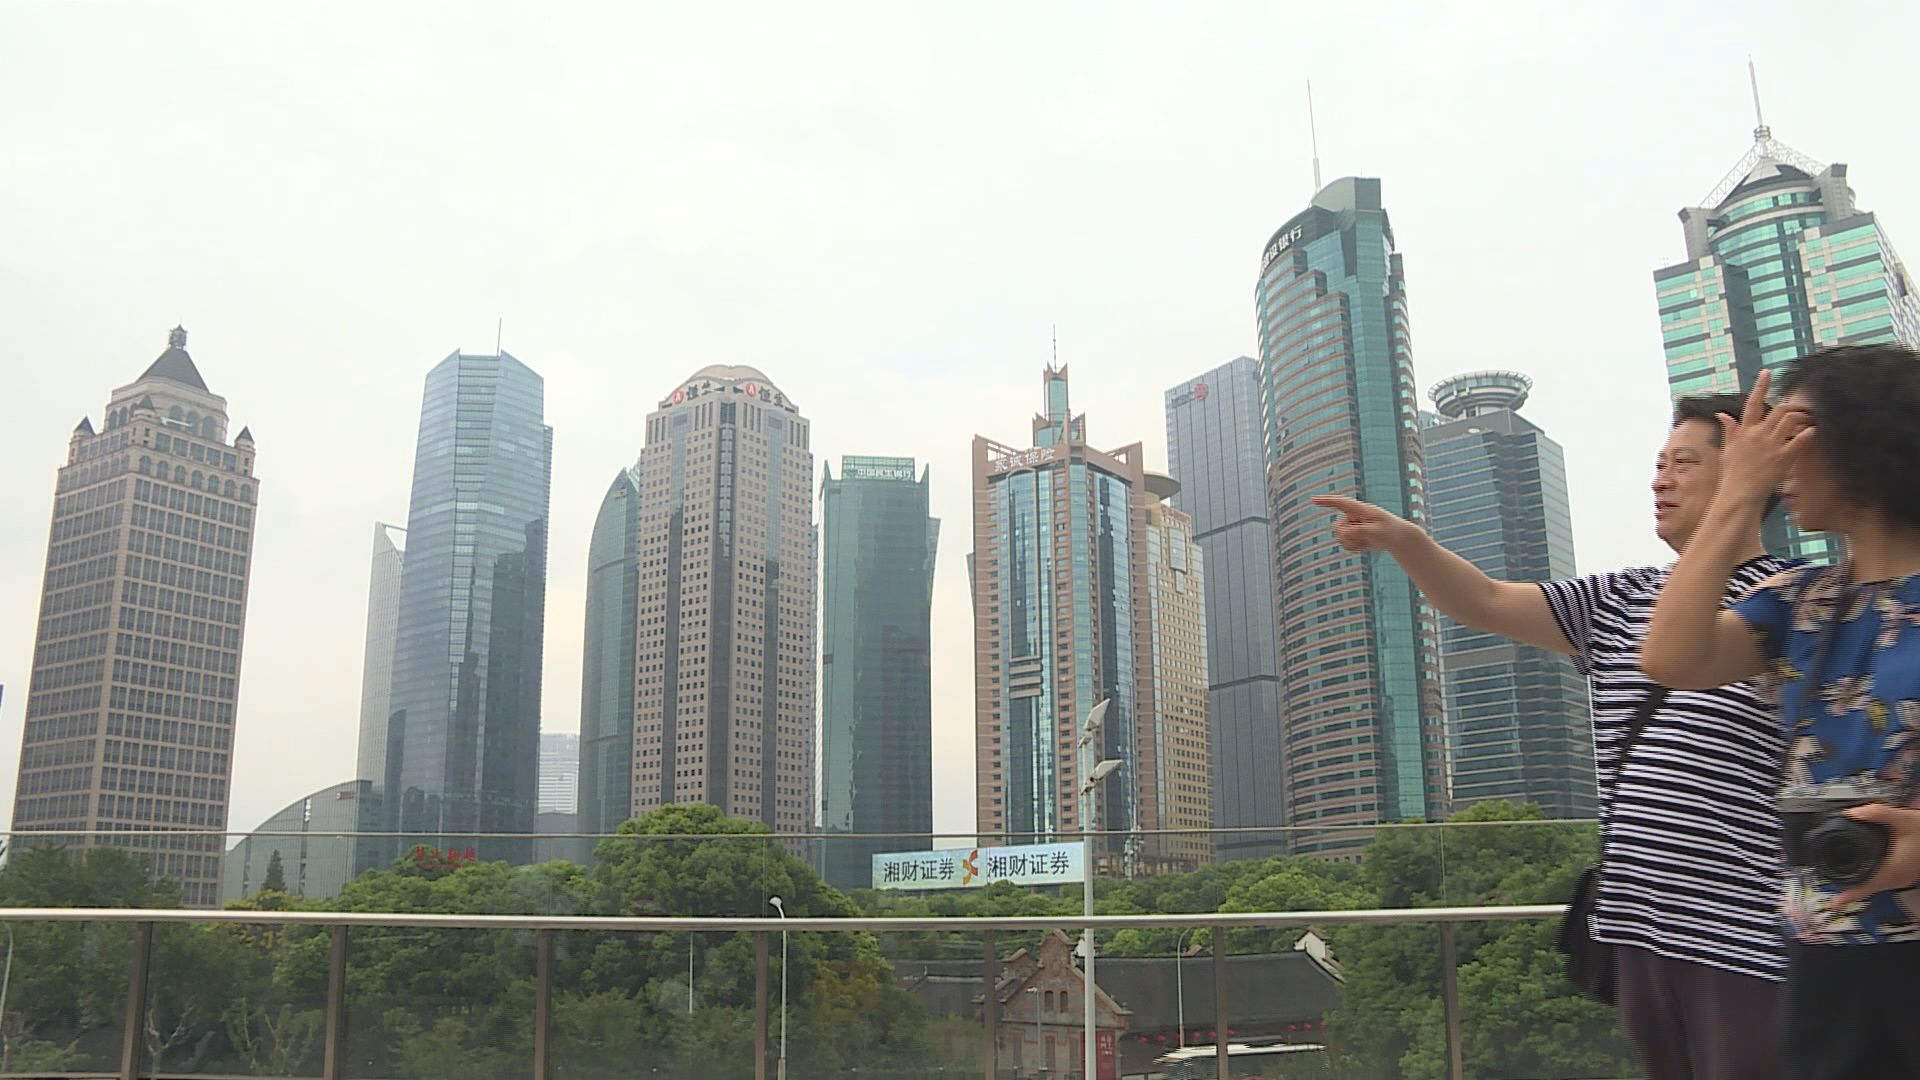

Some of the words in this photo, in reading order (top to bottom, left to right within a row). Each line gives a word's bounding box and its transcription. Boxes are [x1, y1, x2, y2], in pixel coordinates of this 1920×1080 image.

[883, 857, 954, 883] 湘财证券
[986, 851, 1069, 877] 湘财证券
